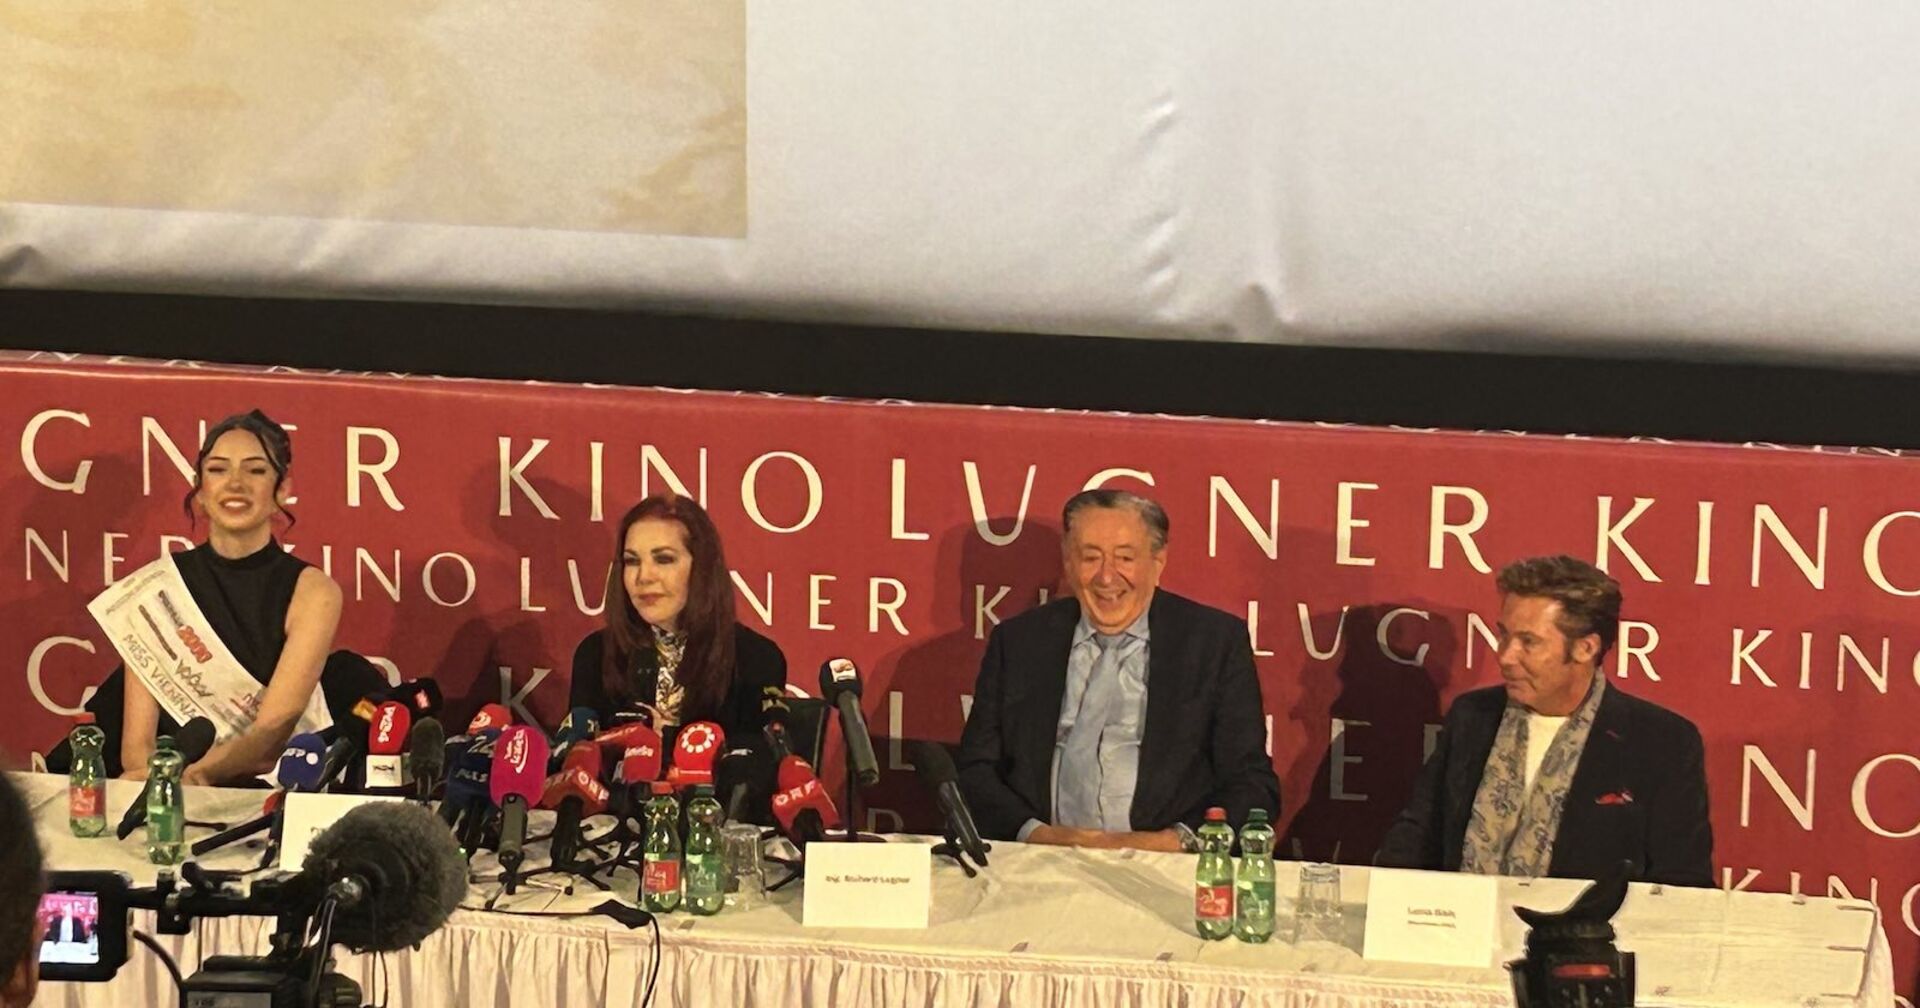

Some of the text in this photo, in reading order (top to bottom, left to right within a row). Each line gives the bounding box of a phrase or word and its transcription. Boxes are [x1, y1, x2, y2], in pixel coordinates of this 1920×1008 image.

[20, 409, 1920, 597] GNR KINO LUNER KINO
[122, 633, 153, 668] MISS
[150, 666, 197, 718] VIENNA
[283, 544, 476, 607] INO
[520, 556, 910, 635] LUNER
[1248, 600, 1662, 682] LUGNR
[1730, 628, 1920, 694] KIN
[773, 779, 816, 806] ORF
